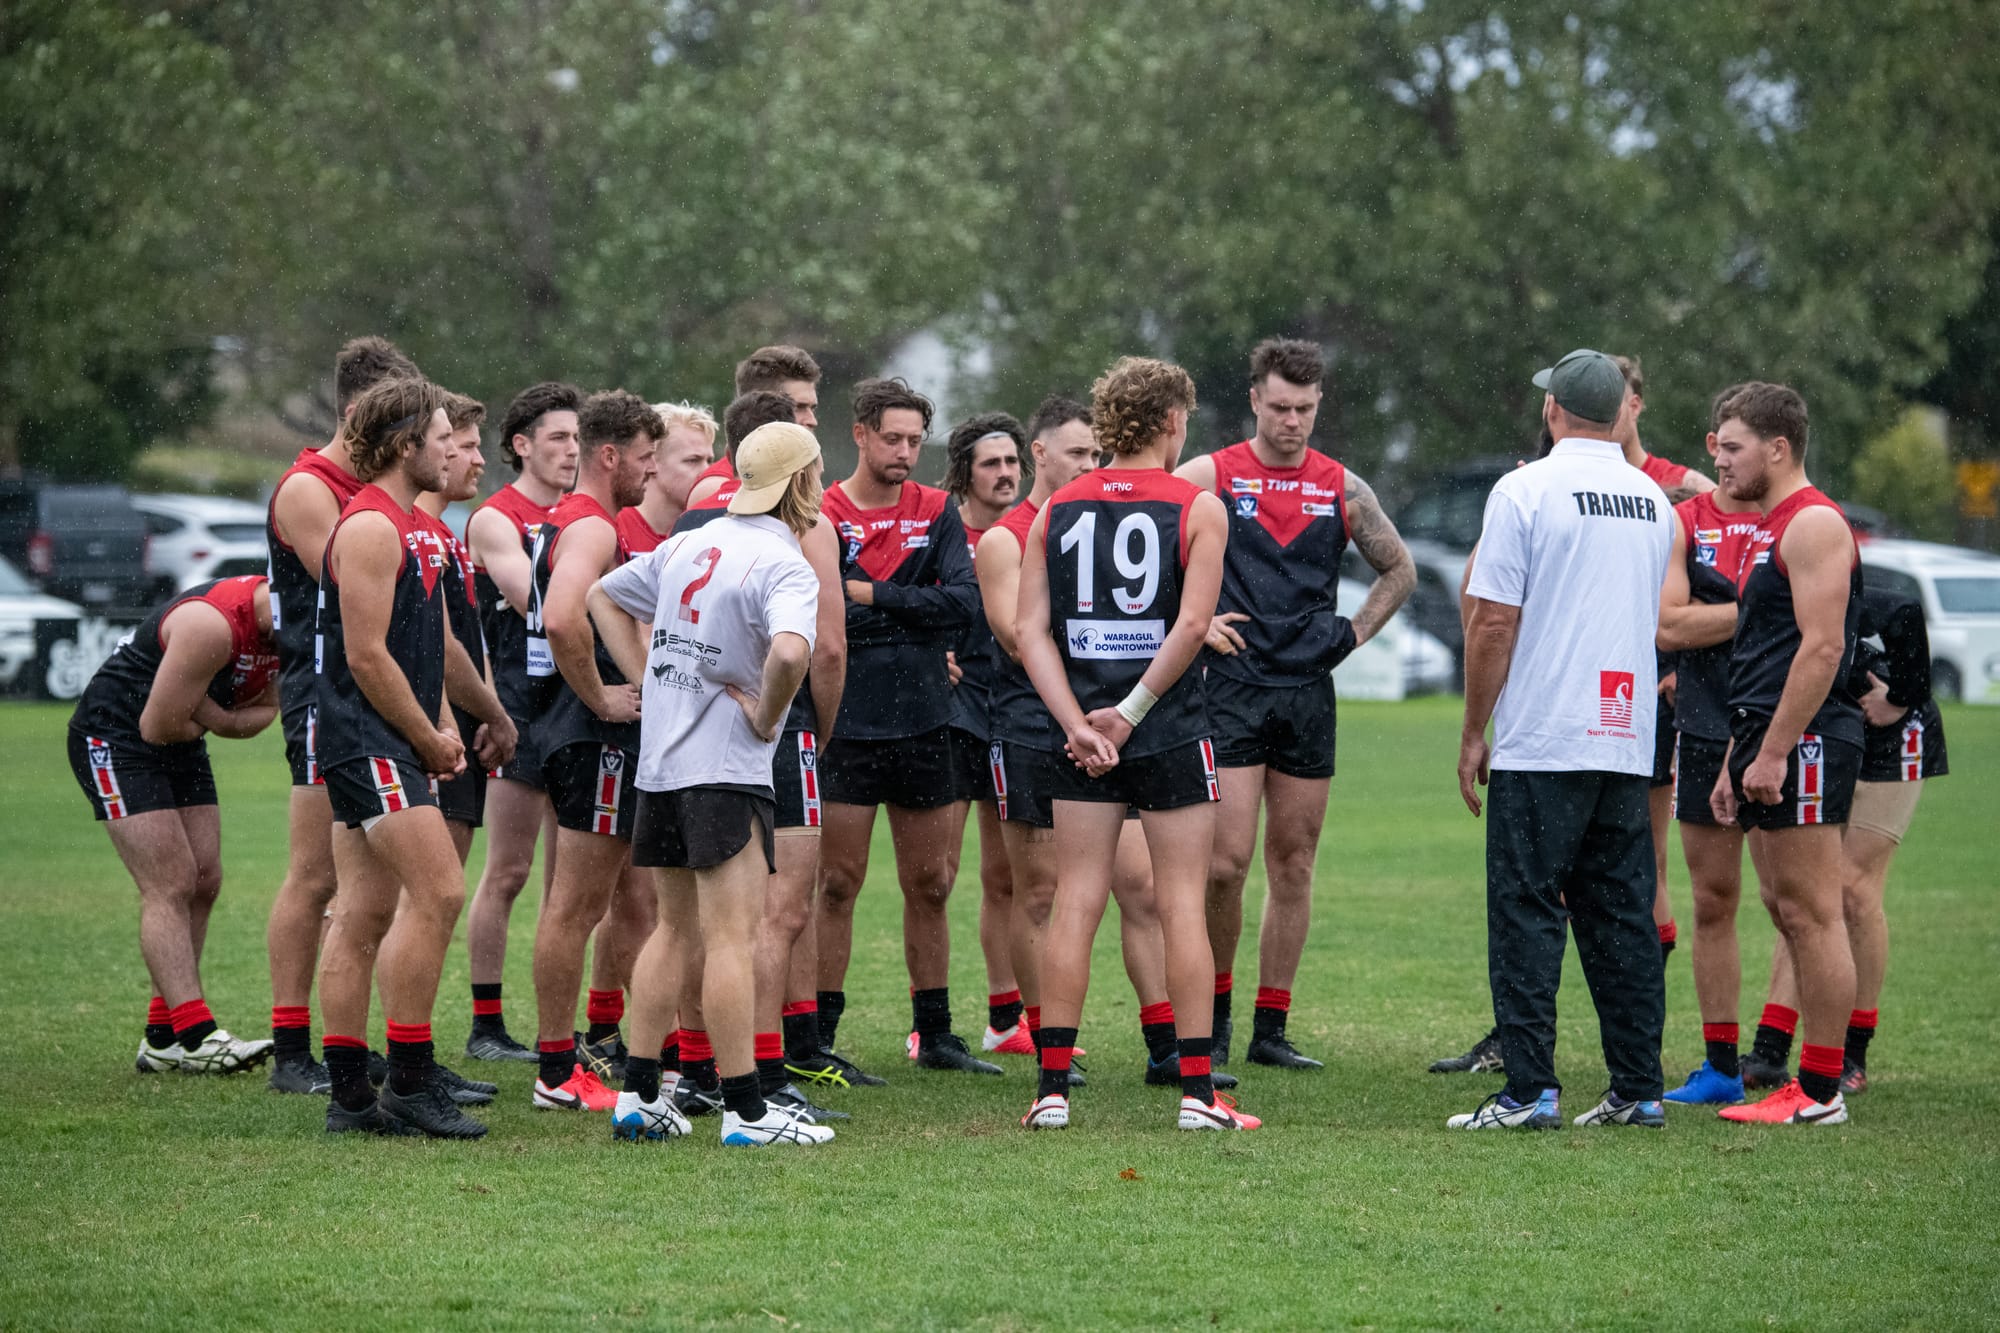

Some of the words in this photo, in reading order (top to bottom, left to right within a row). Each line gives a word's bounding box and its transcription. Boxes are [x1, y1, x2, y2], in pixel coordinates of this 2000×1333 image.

[1103, 482, 1133, 491] WFNC
[1267, 479, 1300, 491] TWP
[718, 492, 736, 501] WF
[1572, 491, 1657, 523] TRAINER
[870, 519, 896, 530] TWP
[1060, 511, 1160, 615] 19
[678, 546, 722, 625] 2
[1103, 632, 1154, 641] WARRAGUL
